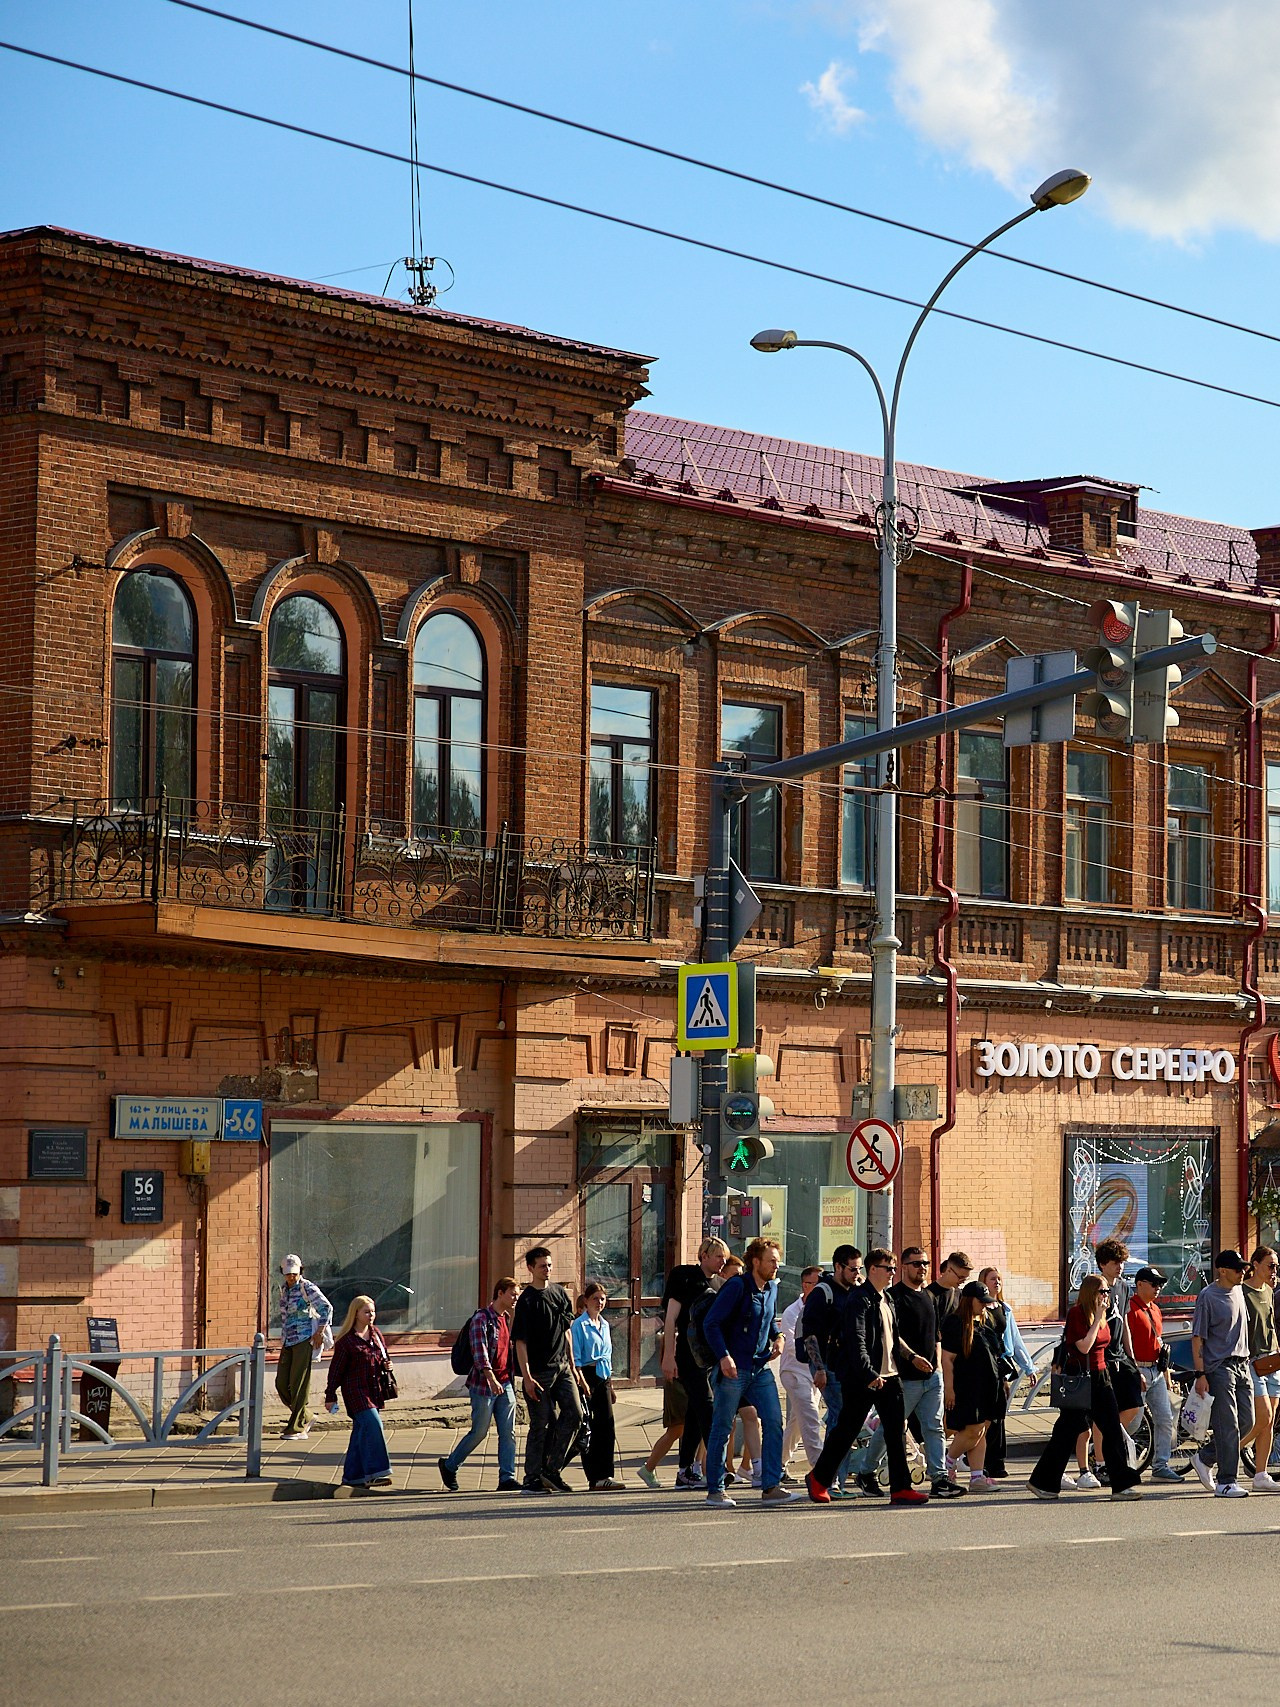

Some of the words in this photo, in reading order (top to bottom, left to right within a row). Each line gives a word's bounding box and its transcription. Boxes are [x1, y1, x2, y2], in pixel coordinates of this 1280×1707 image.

[975, 1041, 1101, 1079] ЗОЛОТО
[1111, 1047, 1235, 1083] СЕРЕБРО
[129, 1105, 142, 1113] 162
[154, 1105, 188, 1115] УЛИЦА
[129, 1117, 208, 1131] МАЛЫШЕВА
[230, 1108, 256, 1132] 56
[134, 1177, 154, 1195] 56
